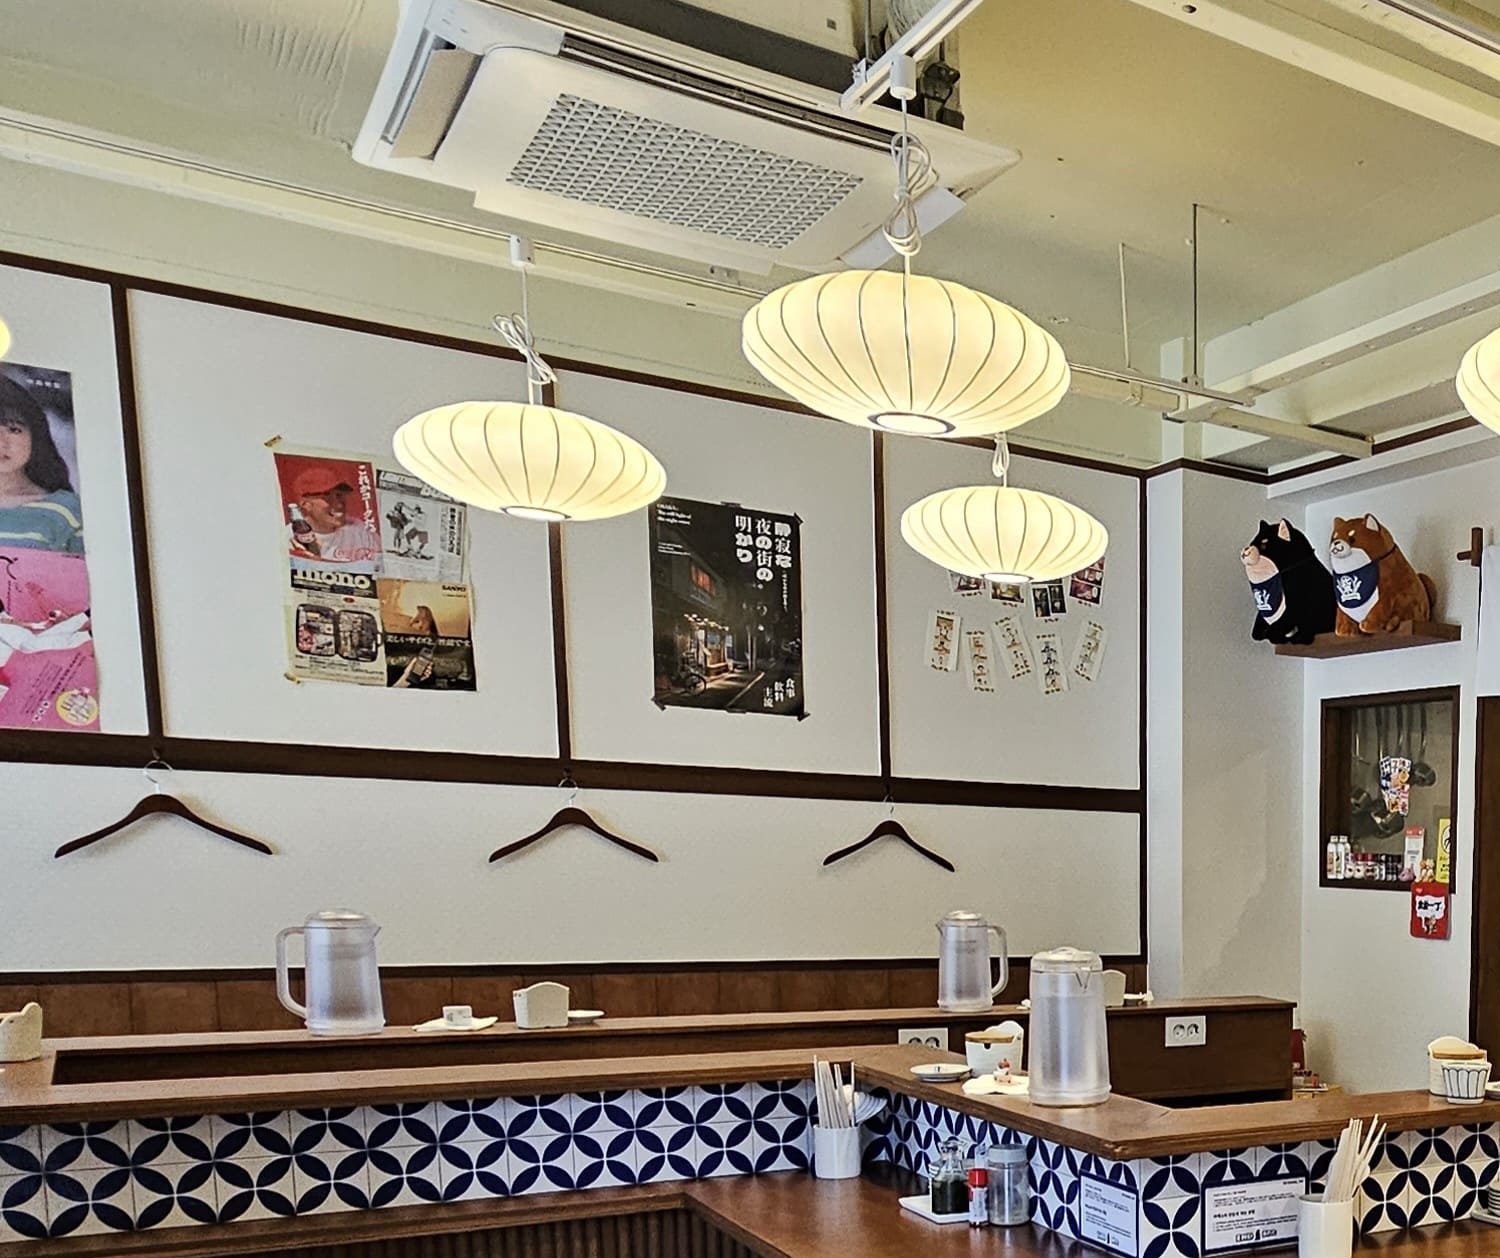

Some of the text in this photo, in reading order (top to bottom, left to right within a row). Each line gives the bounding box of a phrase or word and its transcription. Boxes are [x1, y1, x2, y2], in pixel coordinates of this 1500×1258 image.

[735, 515, 754, 563] 明かり
[756, 518, 774, 582] 夜の街の
[294, 569, 371, 589] mono
